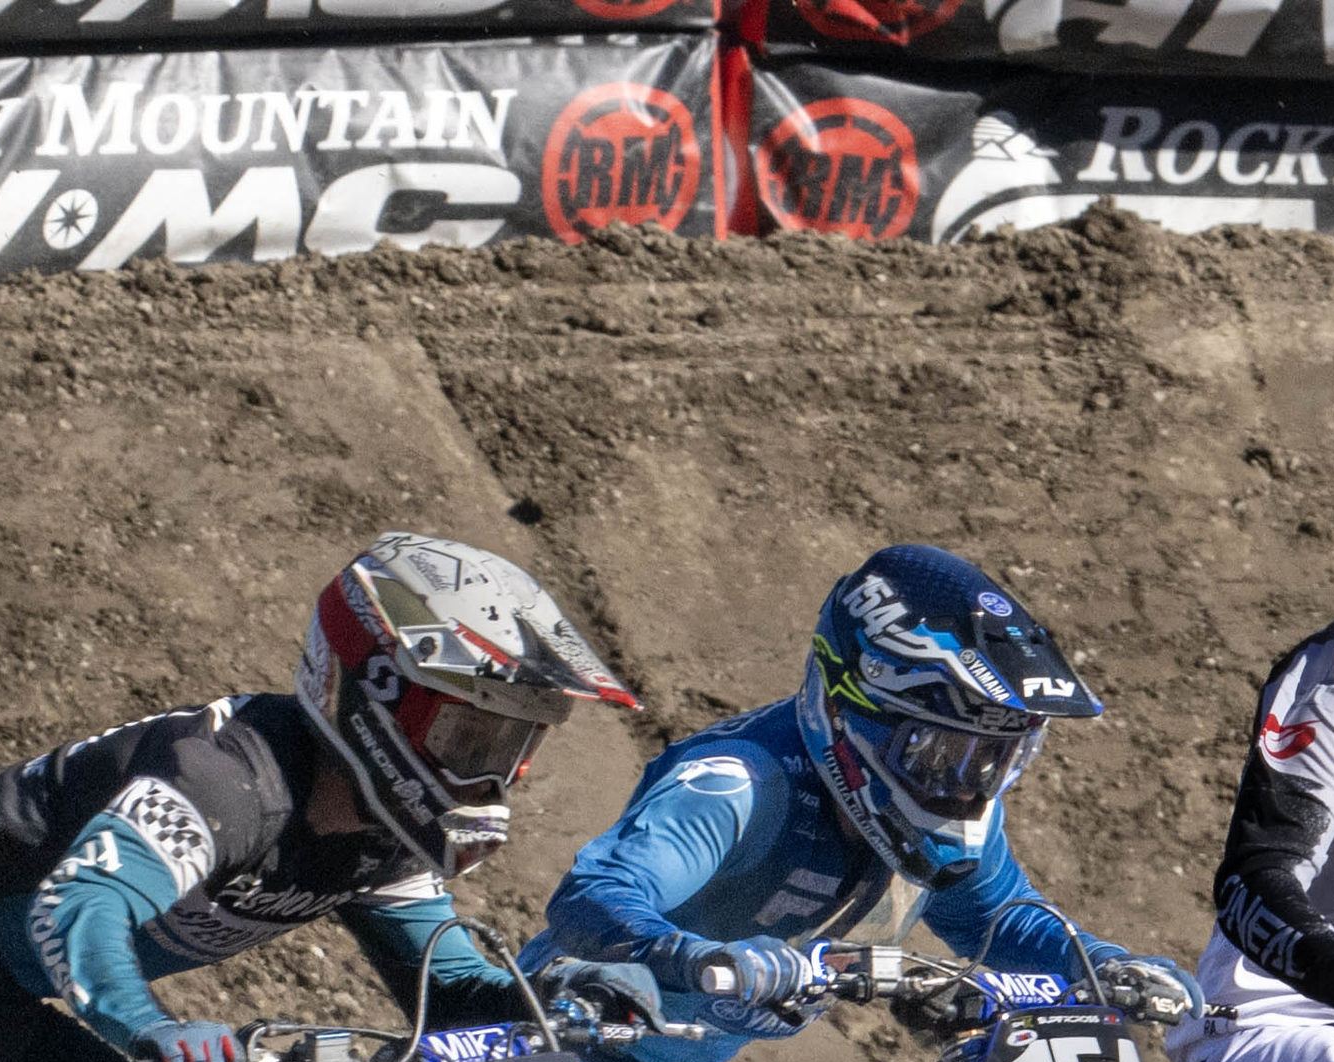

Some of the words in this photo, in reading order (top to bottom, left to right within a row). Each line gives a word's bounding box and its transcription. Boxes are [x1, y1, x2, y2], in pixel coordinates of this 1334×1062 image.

[35, 80, 517, 158] MOUNTAIN
[969, 658, 1012, 703] YAMAHA
[1022, 677, 1076, 698] FLY
